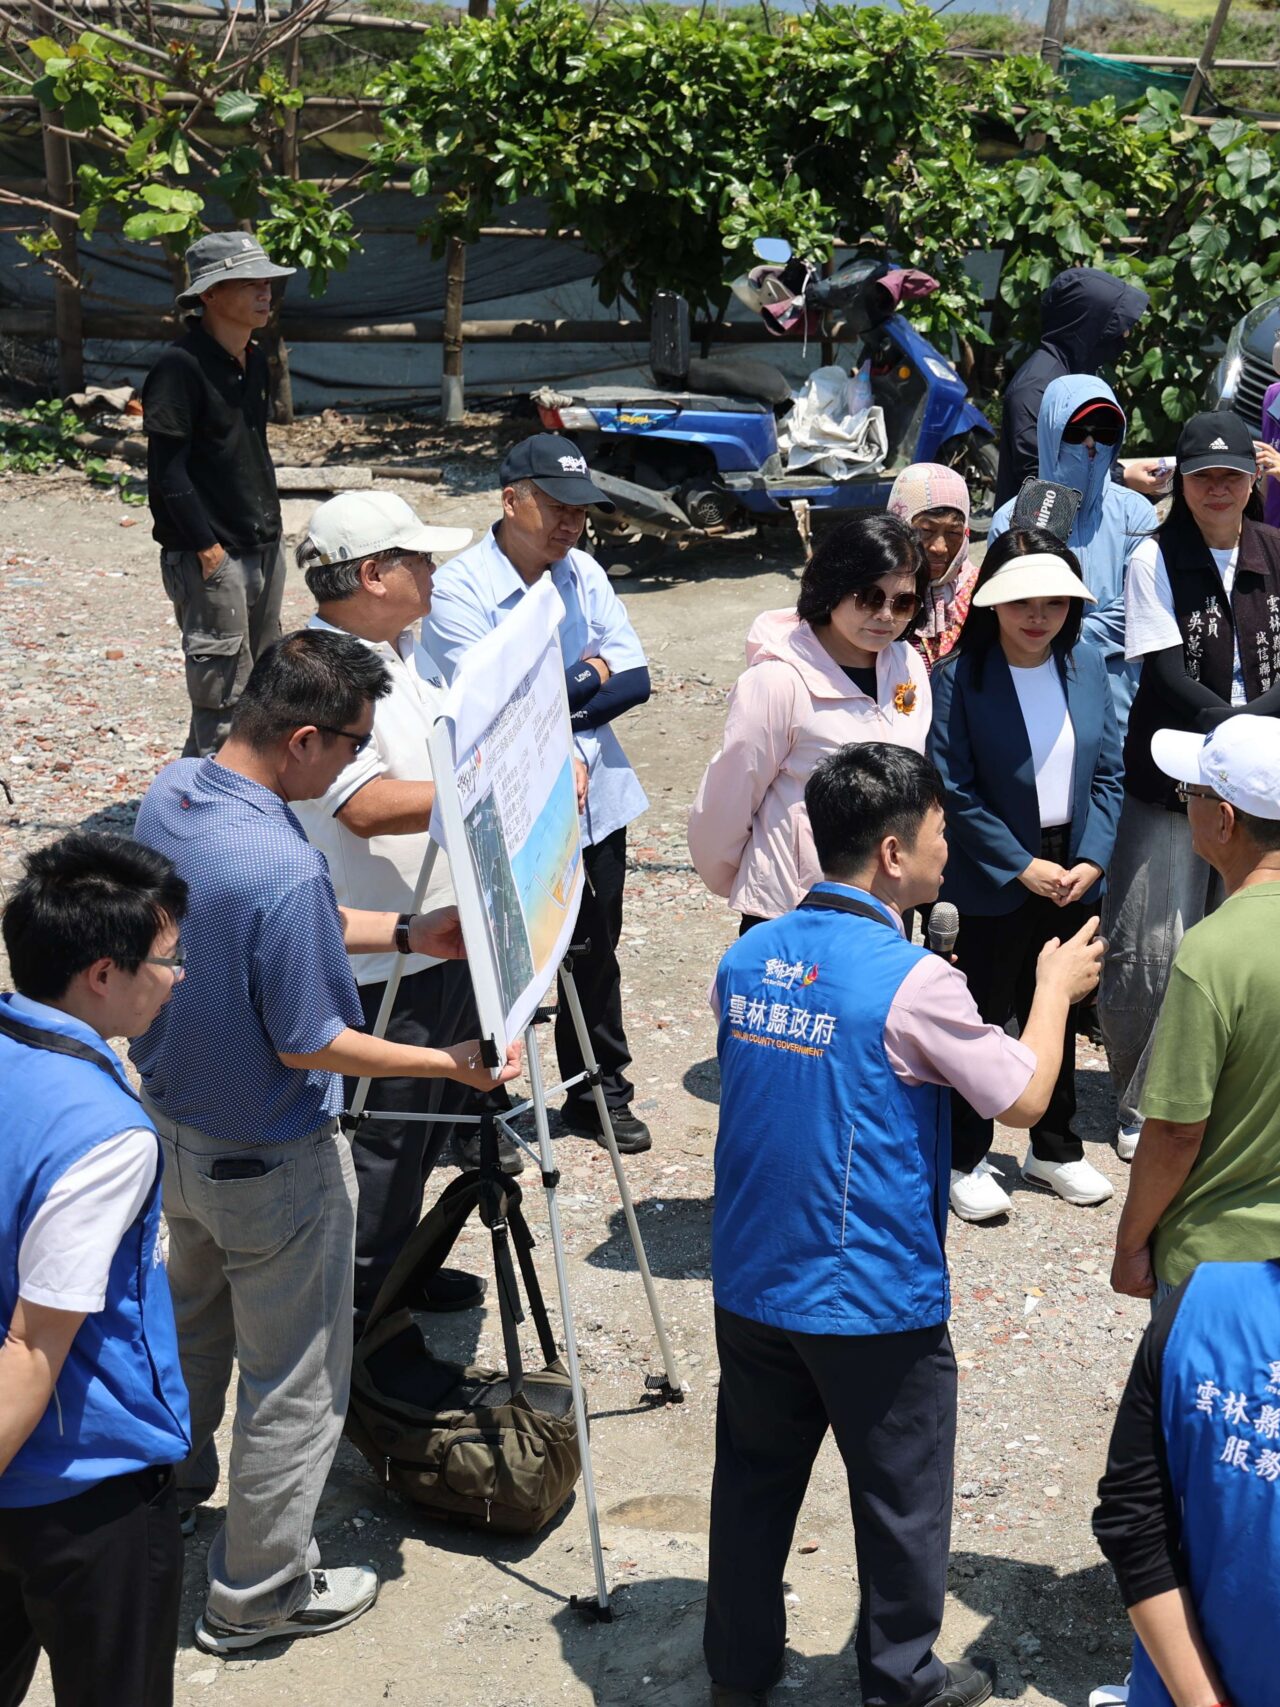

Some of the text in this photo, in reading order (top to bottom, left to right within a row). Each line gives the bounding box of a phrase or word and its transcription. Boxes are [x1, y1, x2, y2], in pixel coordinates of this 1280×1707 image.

[1204, 595, 1222, 639] 議員
[728, 994, 836, 1045] 雲林縣政府
[749, 1033, 776, 1048] COUNTY
[776, 1039, 825, 1058] GOVERNMENT
